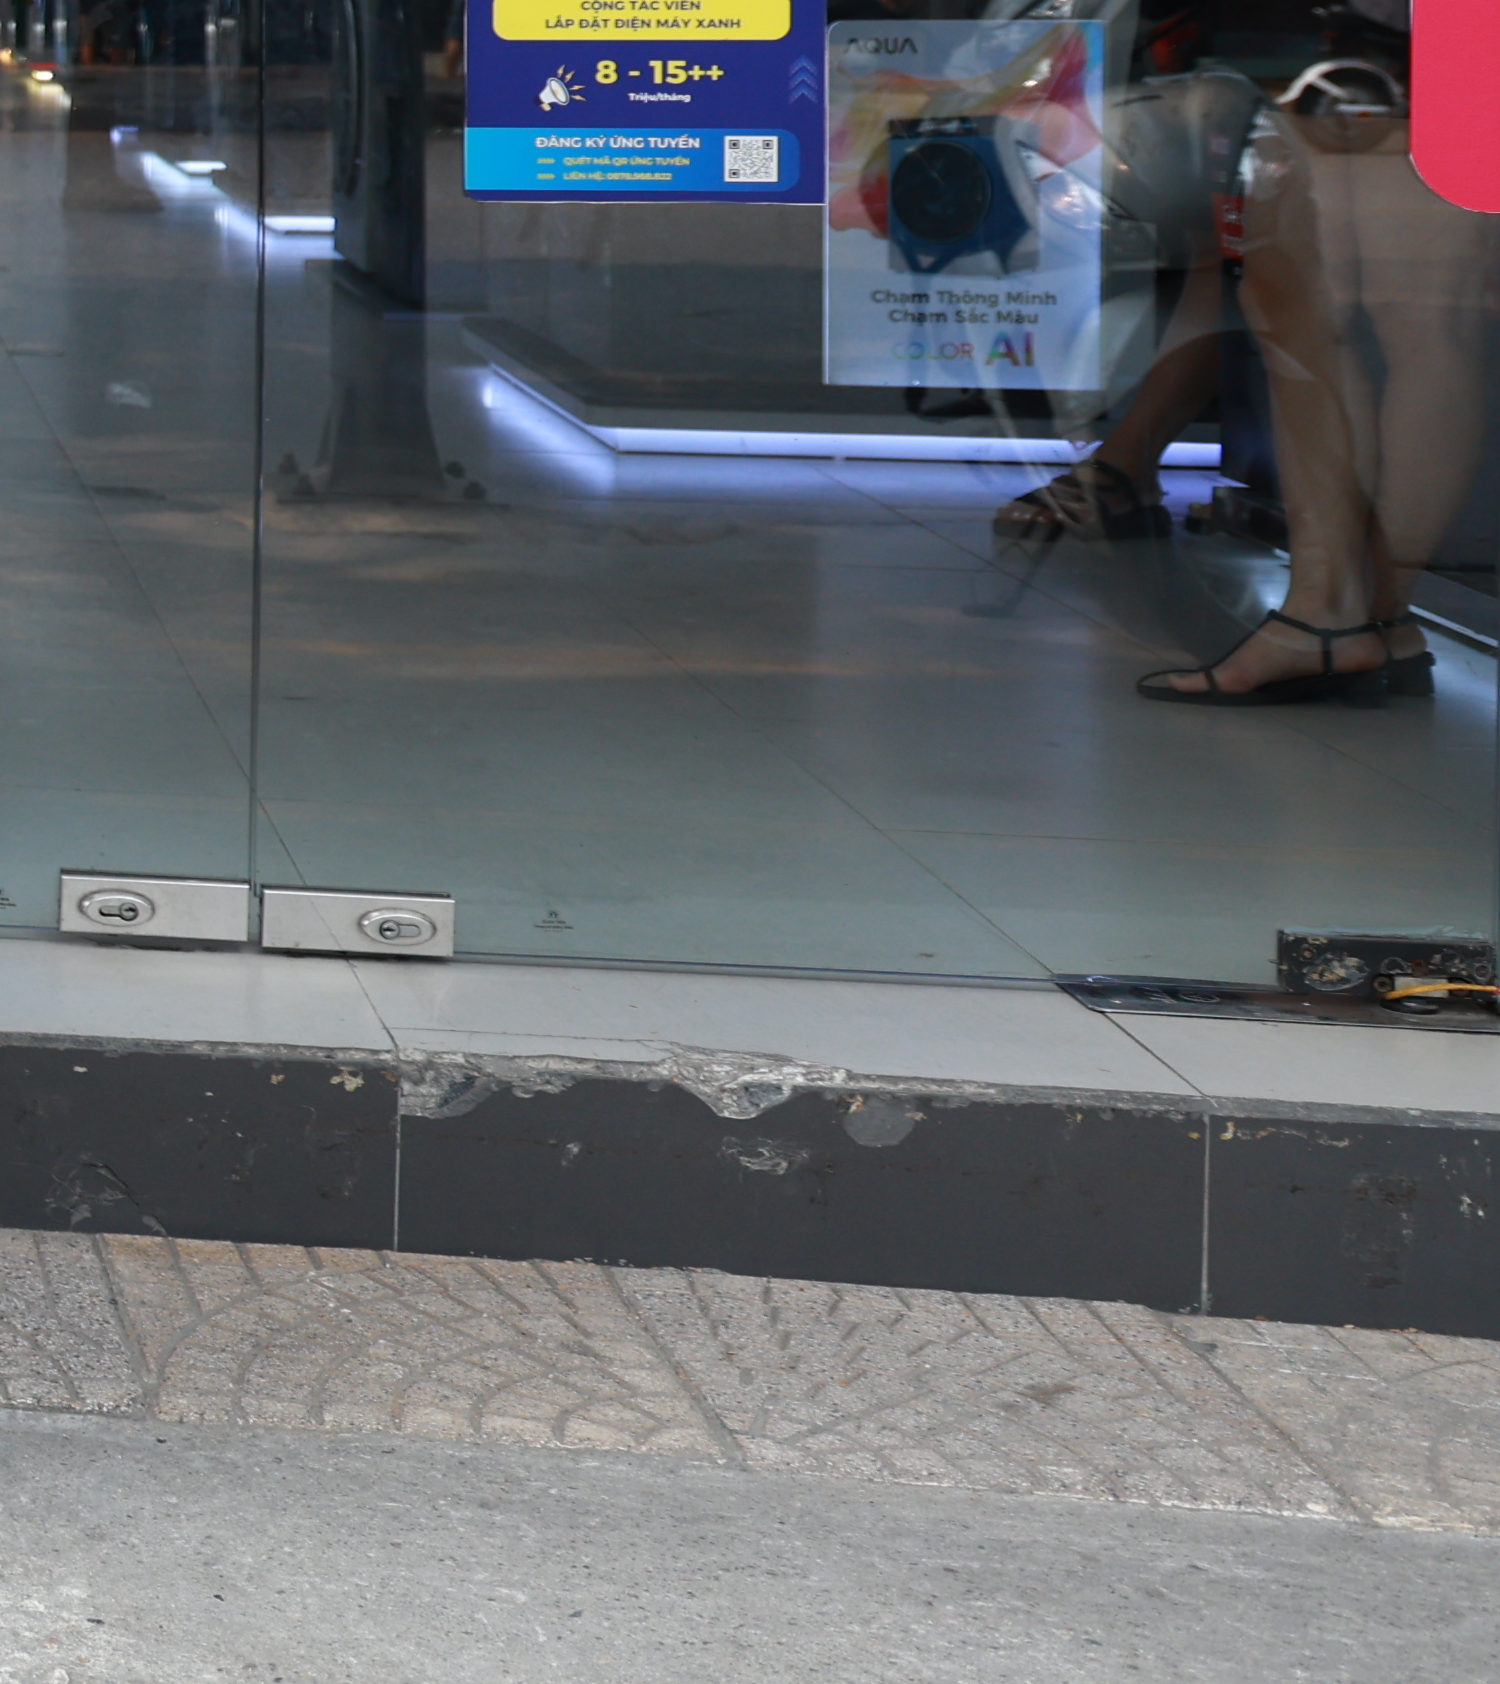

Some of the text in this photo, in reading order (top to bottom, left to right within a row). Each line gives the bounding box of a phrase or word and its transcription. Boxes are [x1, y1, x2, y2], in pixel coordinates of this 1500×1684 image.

[580, 0, 625, 14] CỘNG
[545, 15, 741, 32] LẮP ĐẶT ĐIỆN MÁY XANH
[845, 36, 918, 55] AQUA
[595, 59, 725, 85] 8 15++
[892, 332, 1036, 368] COLOR AI
